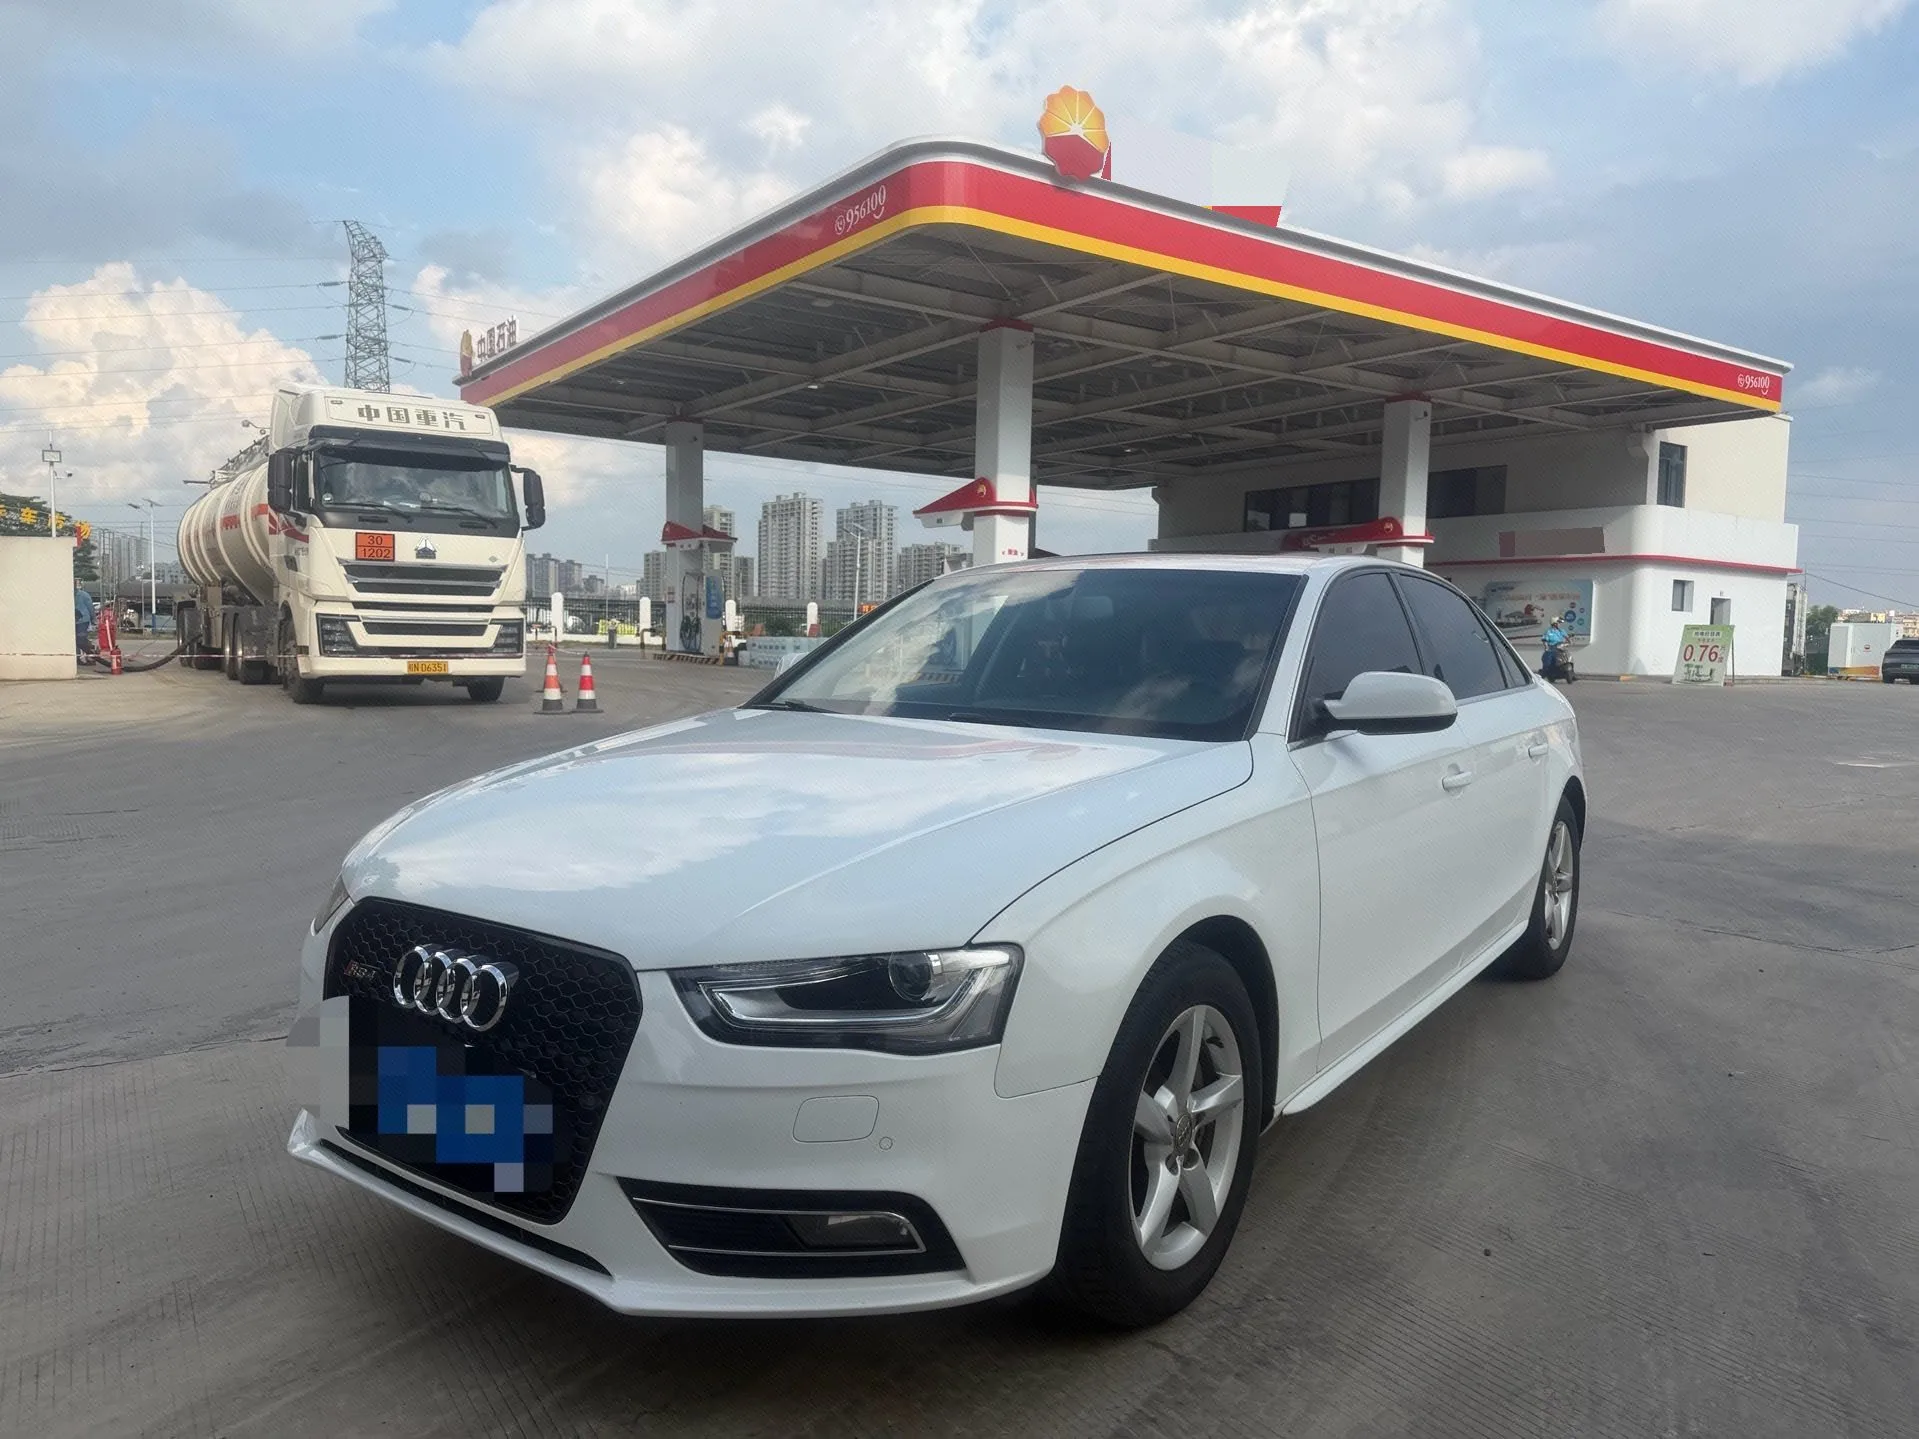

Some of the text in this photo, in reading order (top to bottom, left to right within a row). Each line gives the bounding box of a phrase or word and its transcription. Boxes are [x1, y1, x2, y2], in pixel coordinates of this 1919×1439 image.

[845, 184, 887, 233] 956100
[1745, 375, 1770, 390] 956100
[357, 404, 466, 431] 中国重汽
[367, 535, 383, 546] 30
[361, 547, 391, 559] 1202
[1683, 643, 1720, 662] 0.76
